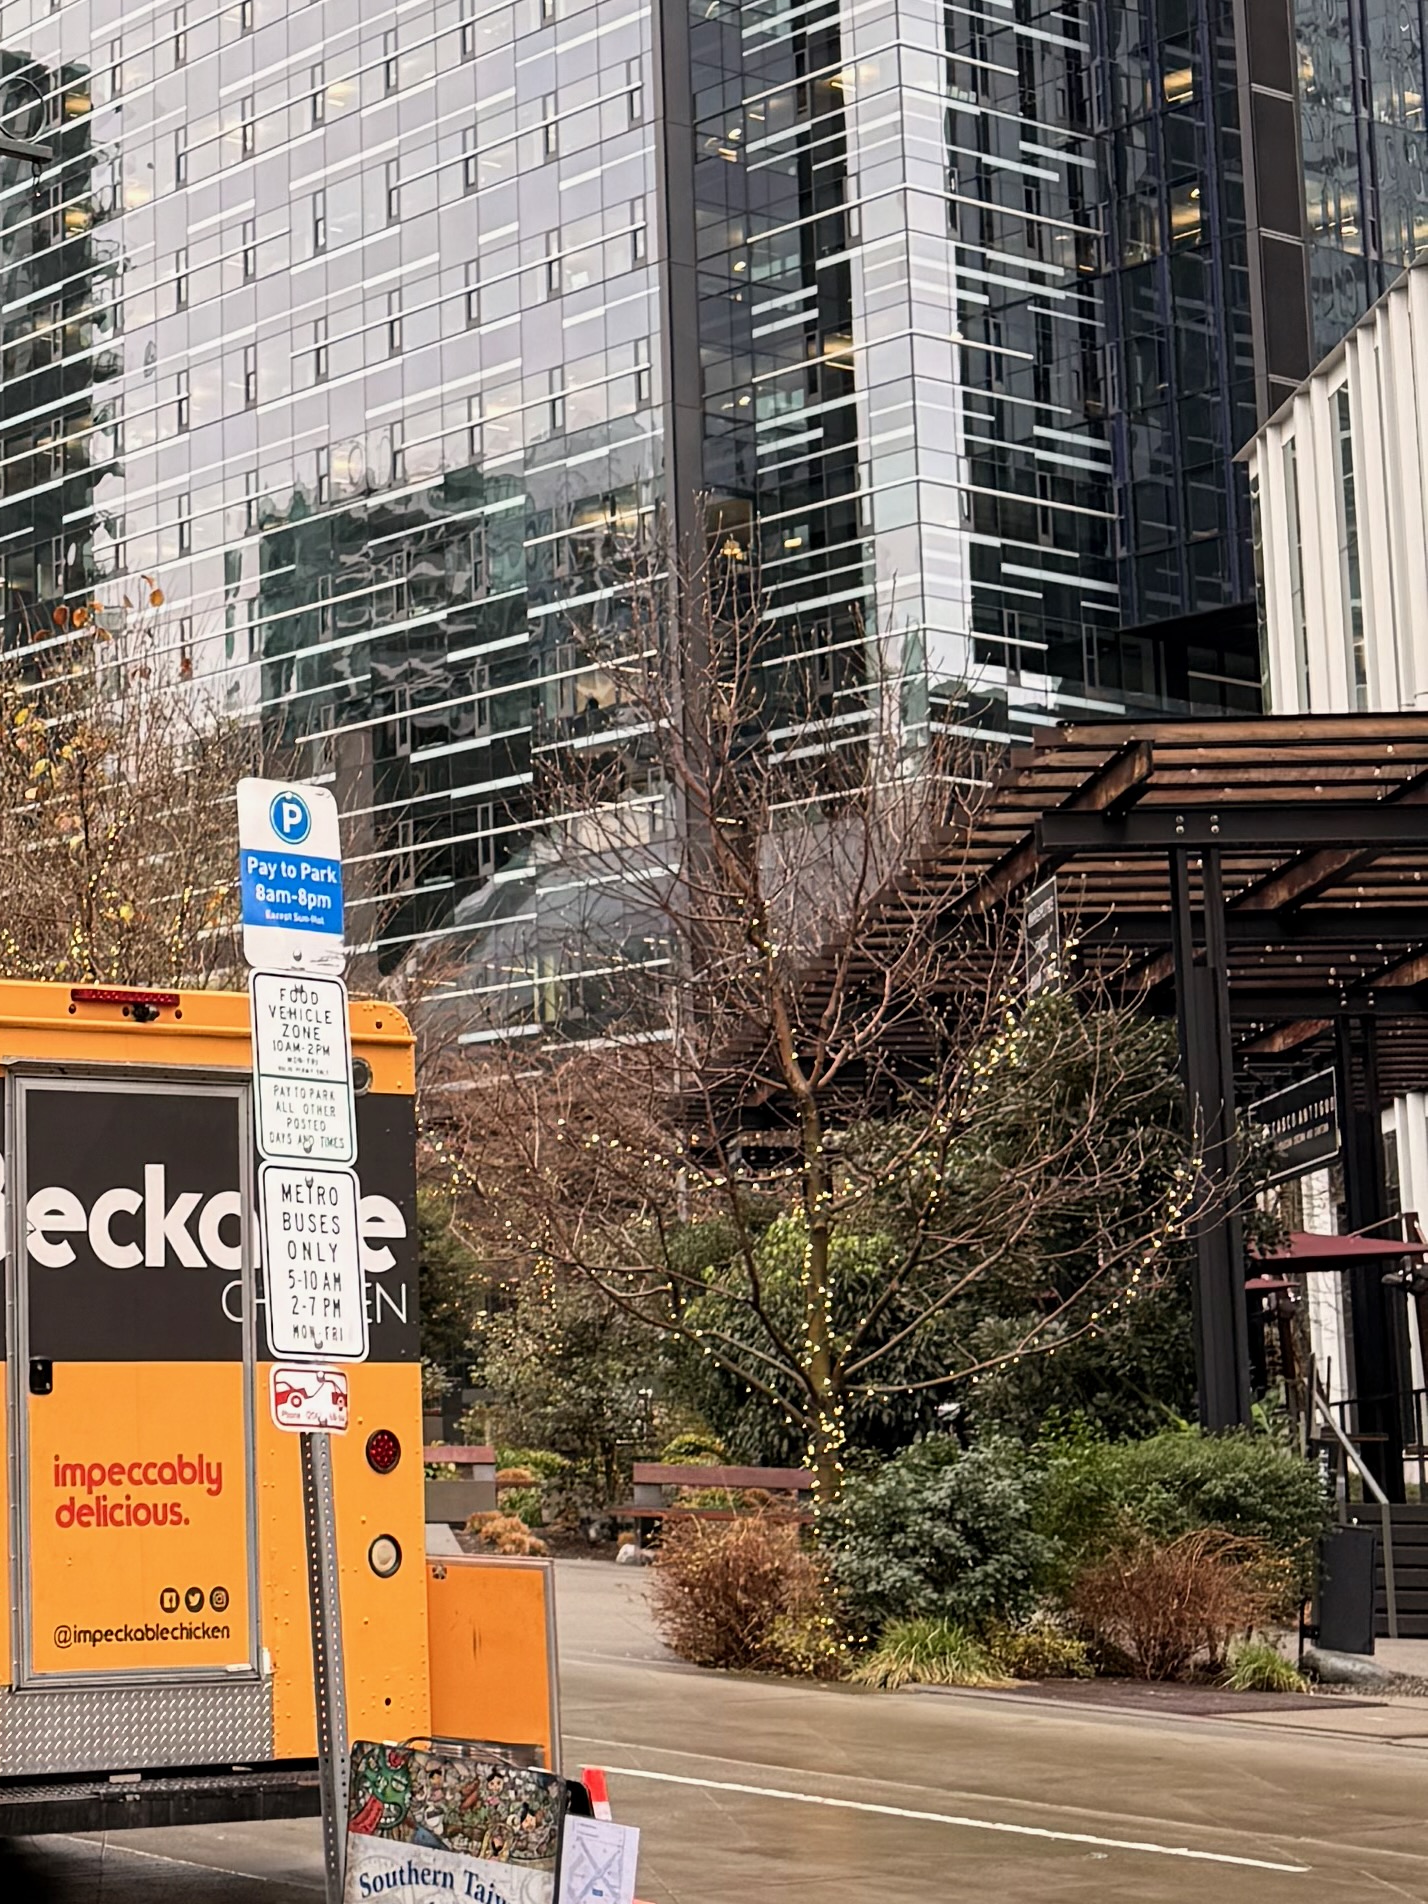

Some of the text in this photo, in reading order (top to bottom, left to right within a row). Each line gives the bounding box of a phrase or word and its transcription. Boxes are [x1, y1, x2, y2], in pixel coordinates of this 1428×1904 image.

[282, 801, 303, 833] P
[247, 856, 338, 884] Pay to Park
[255, 883, 332, 911] 8am-8pm
[279, 987, 319, 1005] FOOD
[268, 1004, 332, 1024] VEHICLE
[282, 1023, 321, 1041] ZONE
[273, 1084, 336, 1101] PAY TO PARK
[275, 1100, 336, 1117] ALL OTHER
[286, 1116, 326, 1132] POSTED
[269, 1131, 293, 1145] DAYS
[281, 1182, 339, 1206] METRO
[282, 1211, 340, 1235] BUSES
[287, 1239, 338, 1263] ONLY
[288, 1269, 342, 1292] 5-10 AM
[291, 1295, 341, 1318] 2-7 PM
[53, 1453, 223, 1497] impeccably
[55, 1494, 190, 1528] delicious.
[53, 1621, 230, 1649] @impeckablechicken
[359, 1859, 454, 1899] Southern
